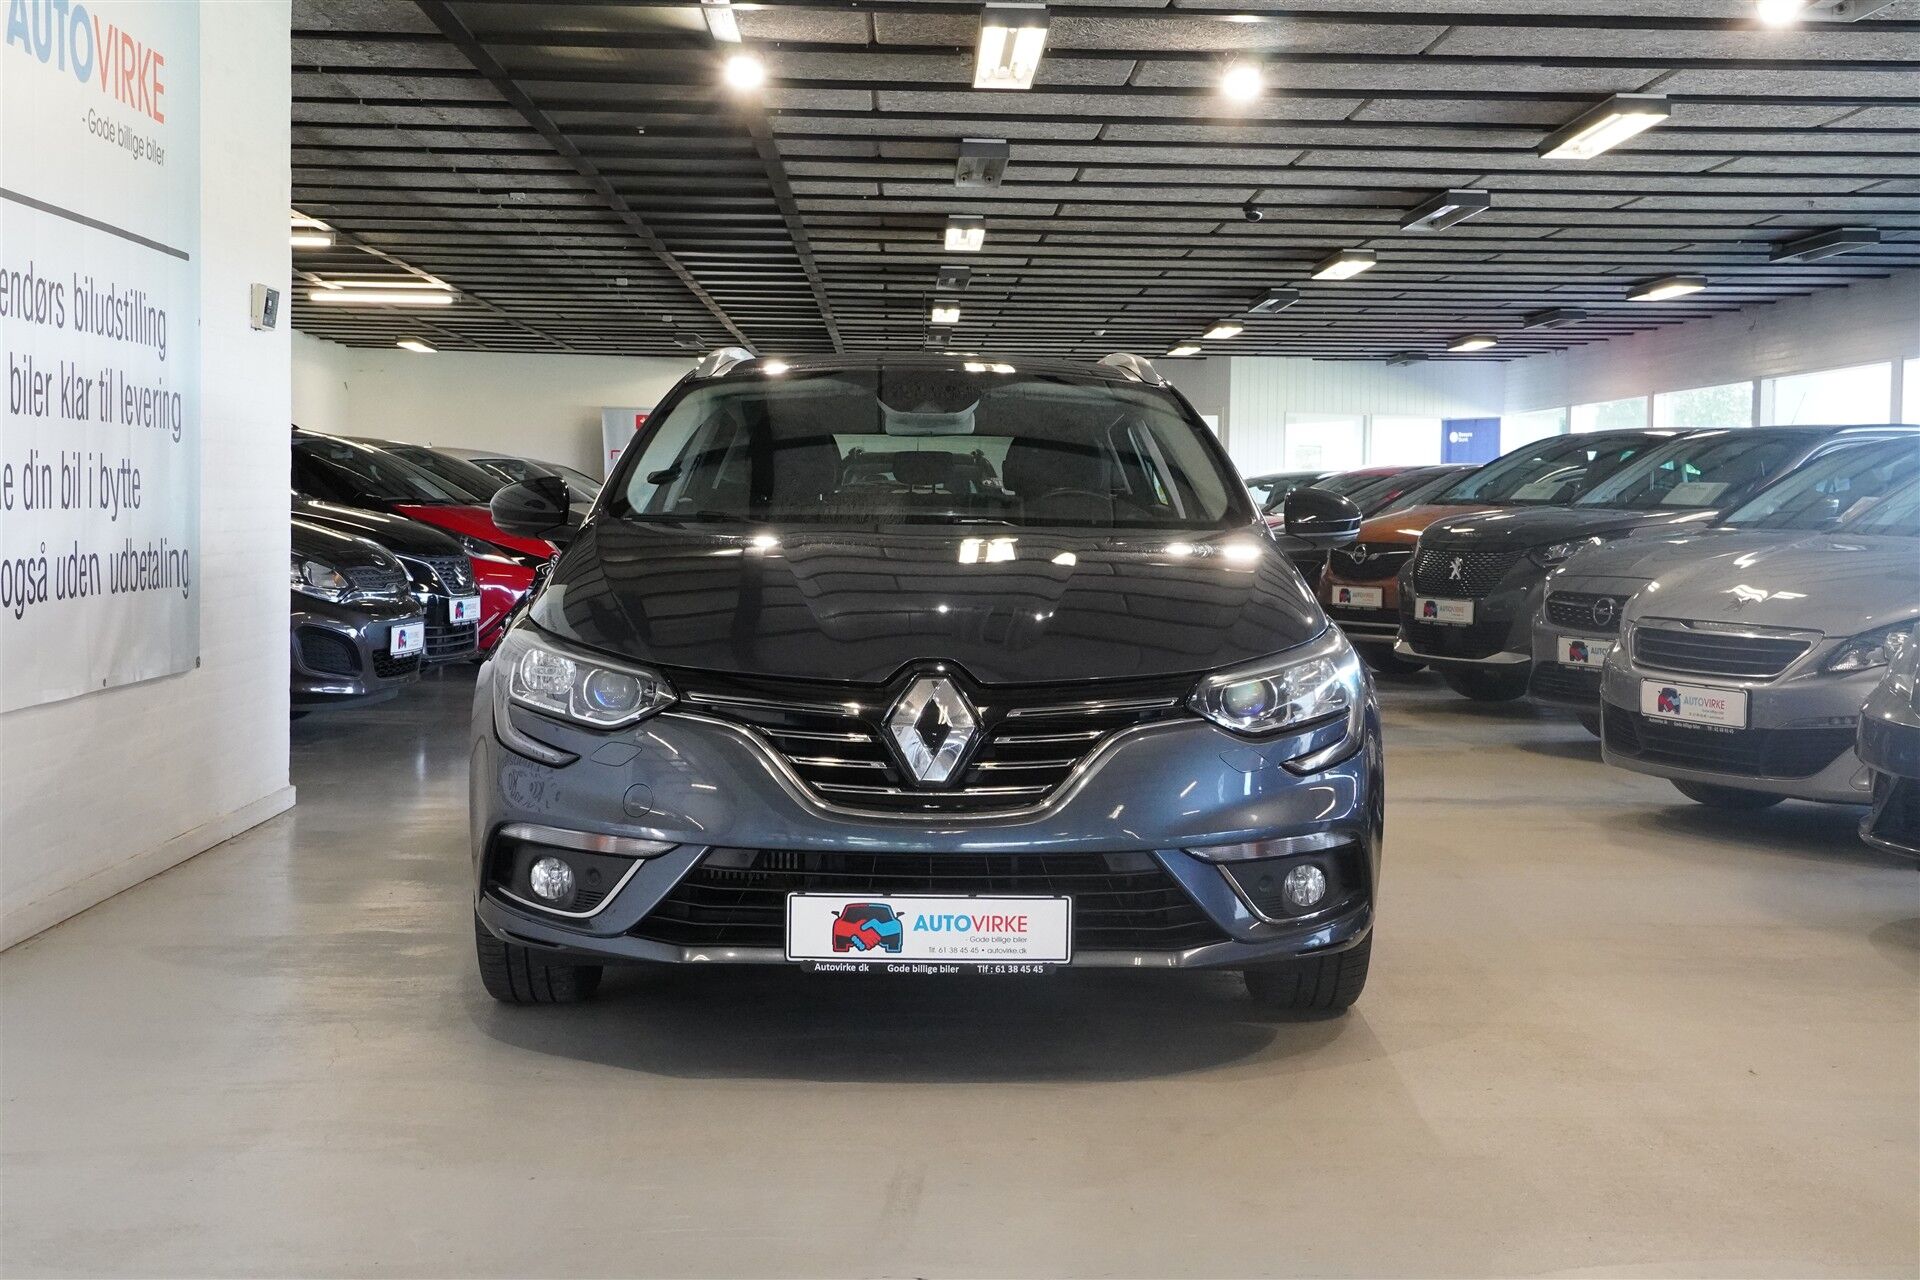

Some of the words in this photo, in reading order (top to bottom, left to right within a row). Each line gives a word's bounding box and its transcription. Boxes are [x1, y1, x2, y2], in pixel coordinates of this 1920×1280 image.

[6, 0, 164, 124] AUTOVIRKE
[88, 108, 115, 143] Gode
[118, 120, 144, 160] billige
[146, 135, 164, 166] biler
[0, 260, 65, 328] endørs
[73, 272, 166, 361] biludstilling
[9, 351, 52, 417] biler
[61, 360, 93, 421] klar
[99, 368, 112, 423] til
[120, 370, 181, 443] levering
[23, 449, 52, 511] din
[61, 450, 81, 510] bil
[89, 452, 92, 509] i
[100, 452, 141, 522] bytte
[1, 541, 48, 620] også
[56, 540, 101, 600] uden
[109, 537, 190, 600] udbetaling
[1683, 696, 1726, 710] AUTOVIRKE
[913, 914, 1028, 933] AUTOVIRKE
[814, 963, 856, 972] Autovirke
[887, 964, 910, 973] Gode
[912, 964, 937, 974] billige
[940, 964, 959, 973] biler
[995, 965, 1006, 973] 61
[1007, 965, 1018, 973] 38
[1020, 965, 1031, 973] 45
[1032, 965, 1044, 973] 45
